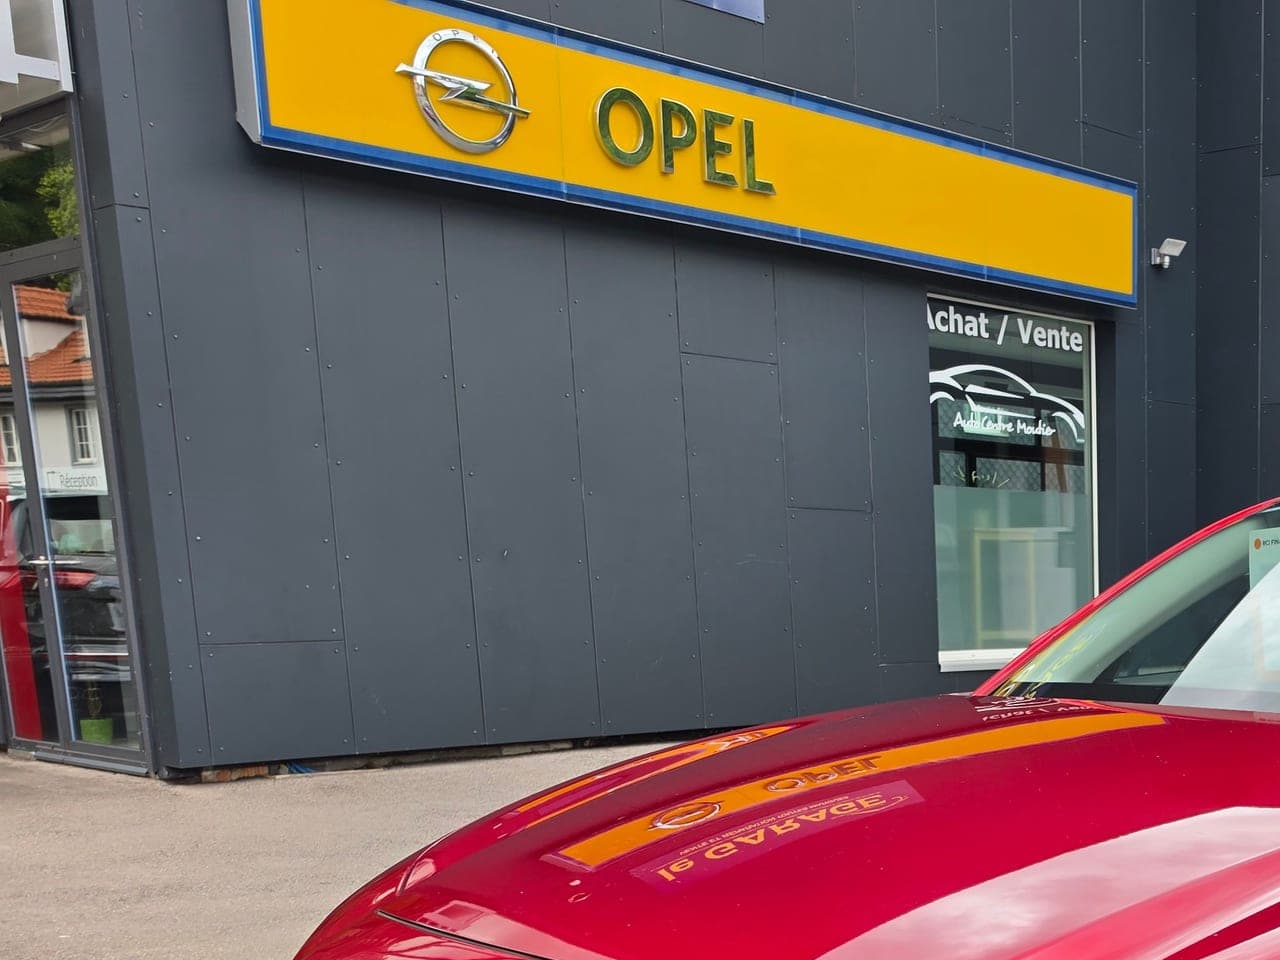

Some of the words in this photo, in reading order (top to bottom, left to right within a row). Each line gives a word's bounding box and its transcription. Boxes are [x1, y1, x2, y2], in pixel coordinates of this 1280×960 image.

[596, 87, 776, 196] OPEL
[996, 315, 1009, 345] /
[1017, 318, 1083, 352] Vente
[59, 473, 98, 489] Réception
